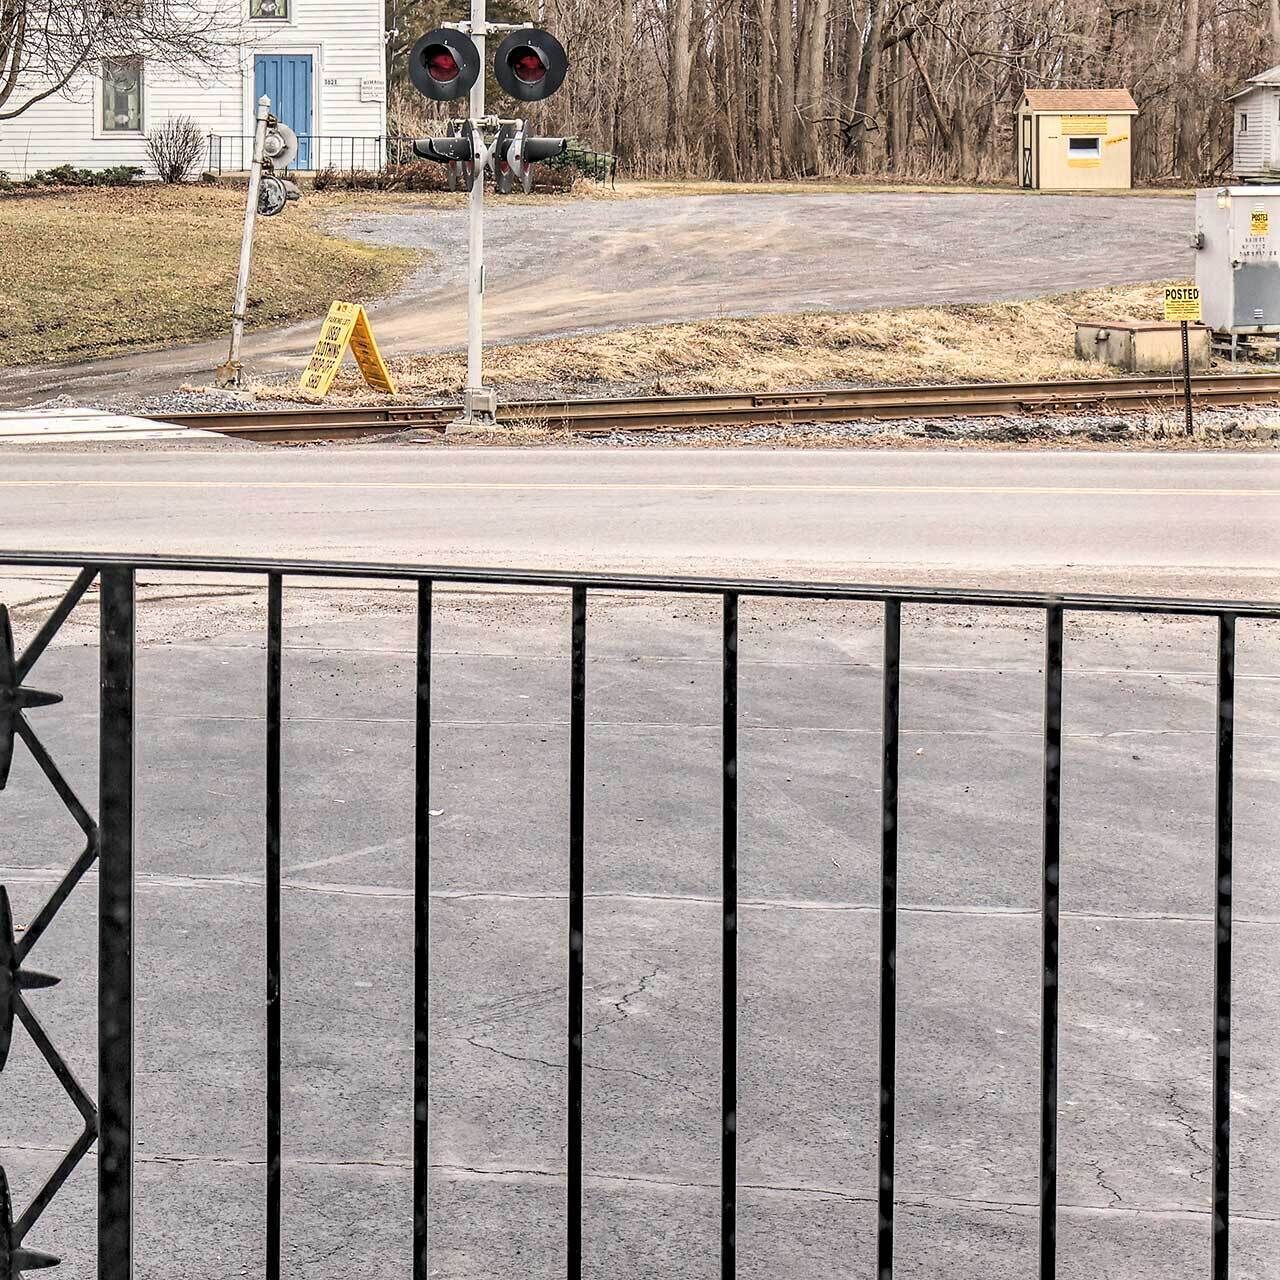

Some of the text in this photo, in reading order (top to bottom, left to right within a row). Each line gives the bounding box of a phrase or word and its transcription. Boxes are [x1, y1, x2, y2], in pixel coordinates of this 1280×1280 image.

[1165, 288, 1199, 300] POSTED
[325, 325, 342, 341] USED
[314, 340, 341, 359] CLOTHING
